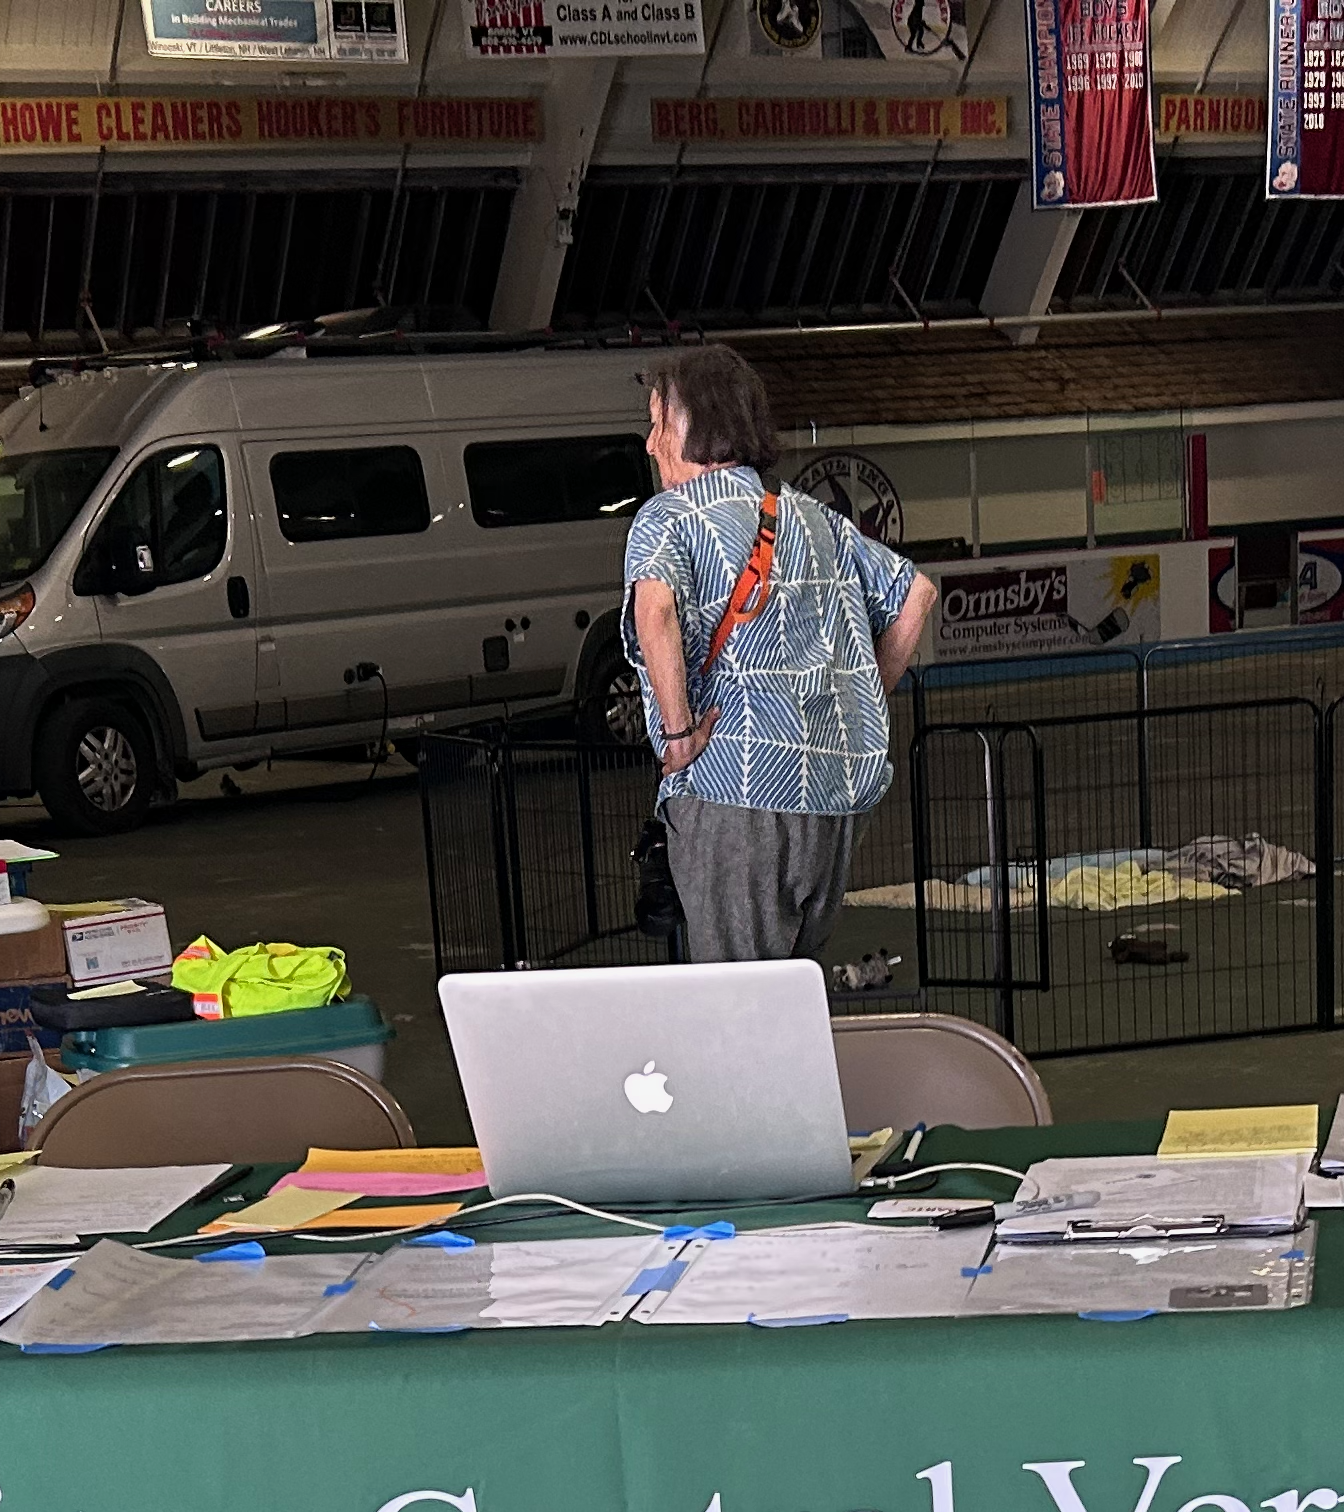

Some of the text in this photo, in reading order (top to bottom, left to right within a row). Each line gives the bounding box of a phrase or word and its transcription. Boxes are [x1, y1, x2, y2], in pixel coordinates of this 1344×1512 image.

[556, 4, 597, 22] Class
[601, 6, 612, 21] A
[616, 7, 637, 21] and
[641, 4, 680, 21] Class
[684, 4, 695, 19] B
[0, 98, 538, 144] HOWE CLEANERS HOOKER'S FURNITURE
[656, 100, 1002, 139] BERG, CARMOLLI & KENT, INC.
[1040, 104, 1064, 168] STATE
[1277, 97, 1297, 158] STATE
[942, 569, 1067, 622] Ormsby's
[939, 616, 1011, 643] Computer
